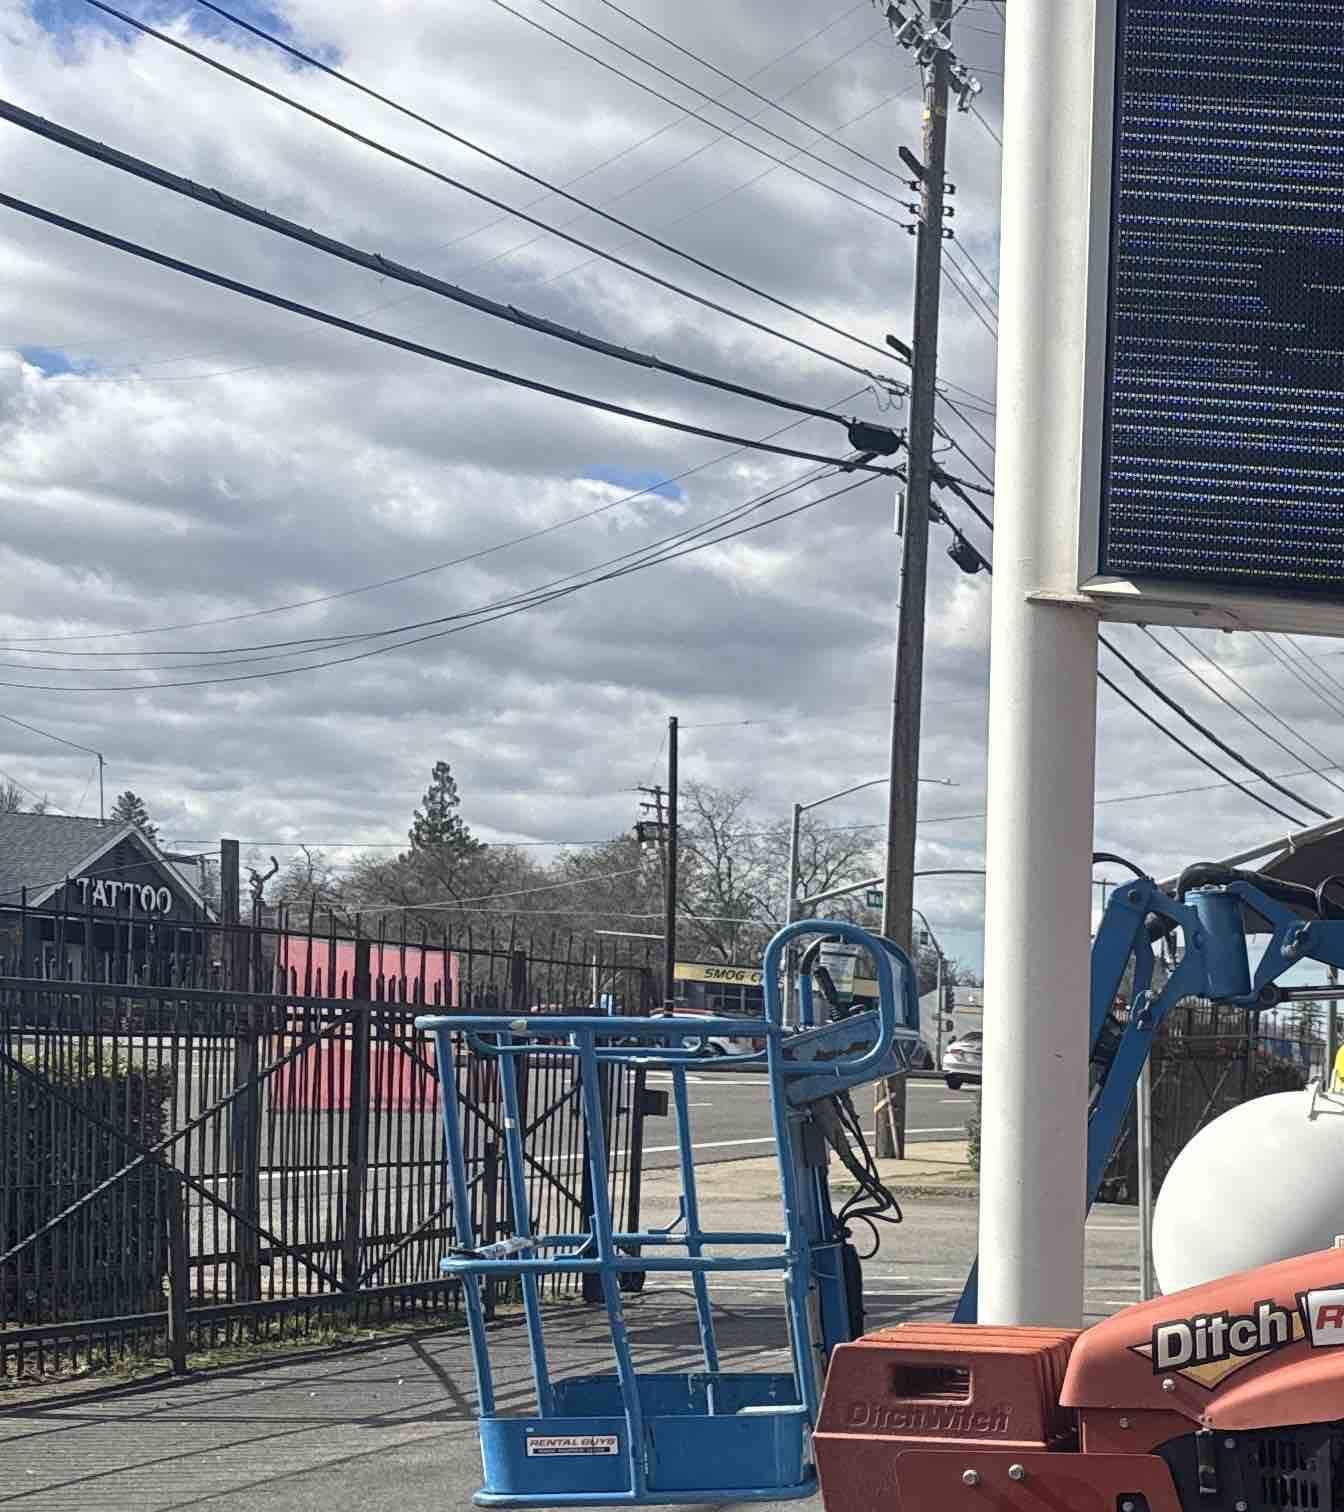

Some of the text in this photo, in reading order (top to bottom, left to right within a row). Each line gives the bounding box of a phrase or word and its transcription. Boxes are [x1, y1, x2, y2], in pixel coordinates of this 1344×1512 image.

[77, 878, 171, 914] TATTOO
[704, 968, 745, 981] SMOG
[1156, 1302, 1289, 1370] Ditch
[529, 1437, 616, 1448] RENTAL GUYS
